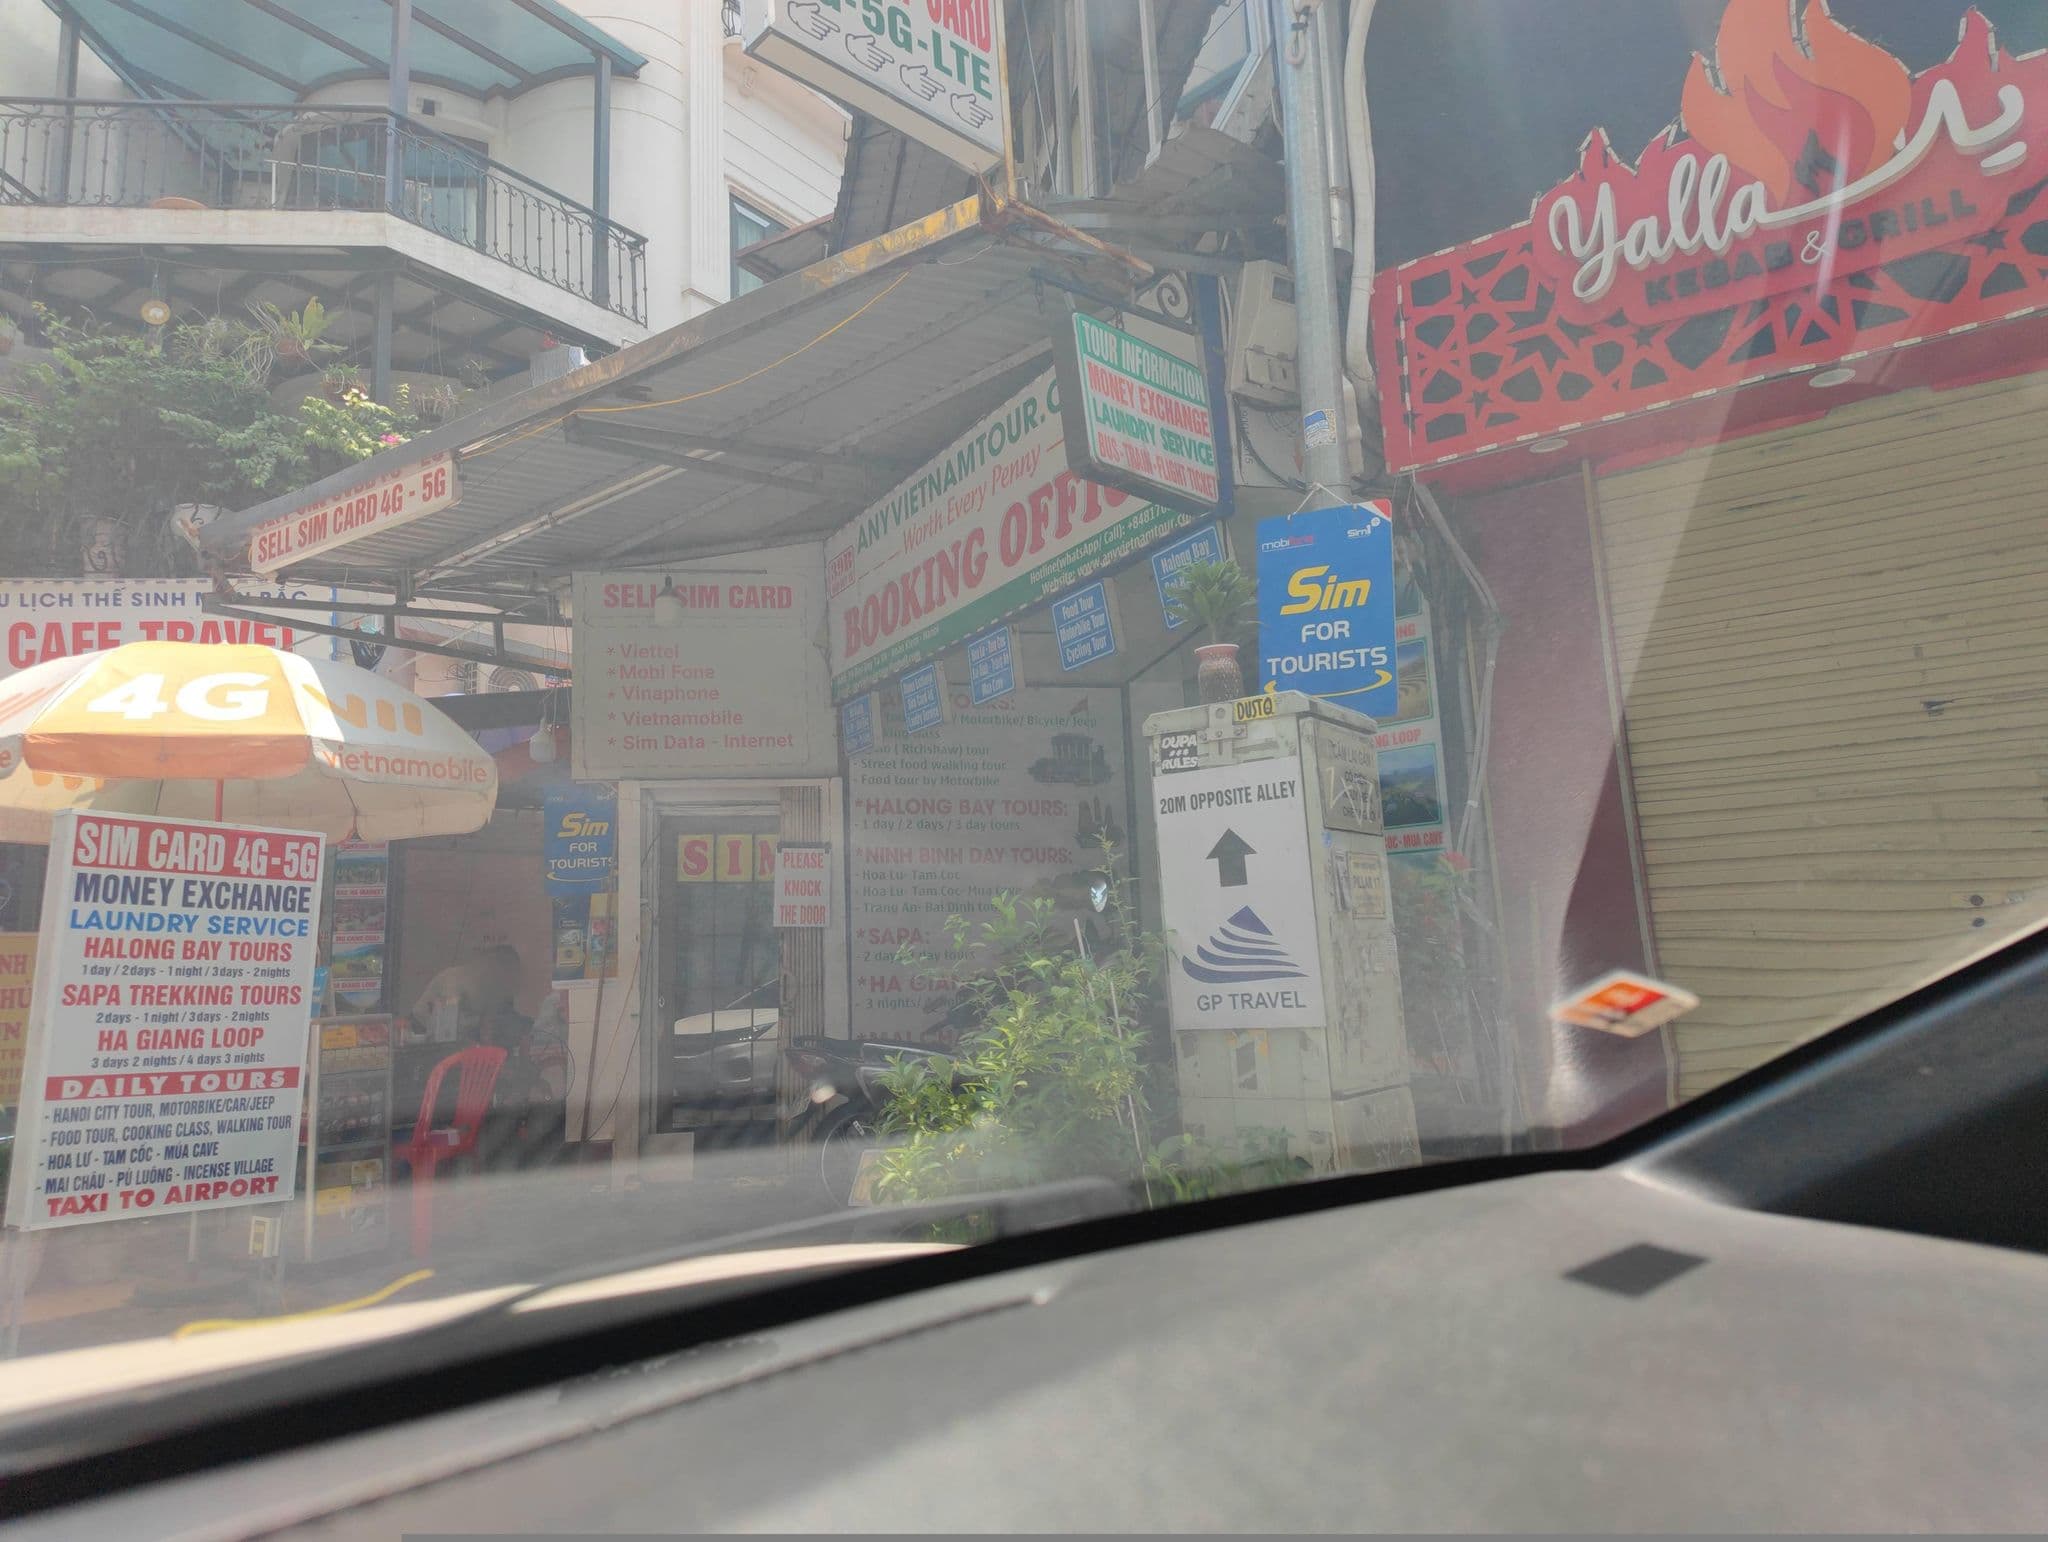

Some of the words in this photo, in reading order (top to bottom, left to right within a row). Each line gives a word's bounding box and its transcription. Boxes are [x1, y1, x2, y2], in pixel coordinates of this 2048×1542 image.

[1548, 153, 1768, 302] Yalla
[1644, 240, 1794, 303] KEBAB
[1801, 230, 1828, 263] &
[1840, 189, 1977, 250] GRILL
[1082, 320, 1118, 364] TOUR
[1121, 338, 1206, 404] INFORMATION
[1087, 361, 1135, 409] MONEY
[1139, 385, 1211, 438] EXCHANGE
[1093, 397, 1155, 446] LAUNDRY
[1160, 427, 1213, 467] SERVICE
[903, 507, 944, 554] Worth
[947, 481, 987, 526] Every
[992, 444, 1041, 496] Penny
[257, 529, 293, 563] SELL
[297, 512, 328, 548] SIM
[332, 493, 378, 535] CARD
[381, 483, 404, 516] 4G
[422, 467, 446, 503] 5G
[20, 592, 73, 613] LỊCH
[82, 587, 126, 607] THẾ
[131, 592, 193, 607] SINH
[672, 584, 720, 609] SIM
[728, 584, 793, 609] CARD
[843, 527, 988, 659] BOOKING
[1280, 565, 1371, 615] Sim
[1301, 620, 1350, 643] FOR
[620, 644, 679, 659] Viettel
[1267, 646, 1388, 676] TOURISTS
[619, 665, 665, 680] Mobi
[671, 665, 715, 679] Fone
[87, 671, 272, 721] 4G
[623, 685, 720, 703] Vinaphone
[623, 710, 744, 726] Vietnamobile
[623, 736, 658, 750] Sim
[664, 735, 705, 749] Data
[724, 734, 793, 748] Internet
[323, 749, 488, 784] vietnamobile
[959, 800, 996, 816] BAY
[1160, 795, 1187, 815] 20M
[1190, 786, 1253, 811] OPPOSITE
[1257, 780, 1296, 802] ALLEY
[557, 812, 609, 837] Sim
[77, 822, 140, 867] SIM
[148, 829, 226, 873] CARD
[569, 842, 597, 853] FOR
[783, 853, 824, 869] PLEASE
[919, 848, 963, 864] BINH
[973, 848, 1005, 864] DAY
[74, 872, 175, 908] MONEY
[182, 879, 312, 914] EXCHANGE
[784, 880, 822, 897] KNOCK
[70, 908, 200, 934] LAUNDRY
[207, 915, 309, 937] SERVICE
[779, 905, 797, 923] THE
[799, 905, 826, 925] DOOR
[84, 937, 176, 960] HALONG
[182, 940, 223, 961] BAY
[228, 942, 292, 962] TOURS
[62, 984, 121, 1006] SAPA
[130, 984, 234, 1006] TREKKING
[240, 985, 302, 1006] TOURS
[1196, 995, 1223, 1012] GP
[1231, 990, 1306, 1010] TRAVEL
[97, 1029, 128, 1052] HA
[136, 1028, 204, 1051] GIANG
[211, 1027, 265, 1049] LOOP
[91, 1057, 99, 1069] 3
[102, 1056, 129, 1069] days
[132, 1056, 140, 1068] 2
[143, 1055, 178, 1069] nights
[186, 1054, 194, 1066] 4
[197, 1054, 222, 1068] days
[224, 1053, 232, 1065] 3
[234, 1052, 265, 1066] nights
[61, 1076, 170, 1099] DAILY
[180, 1070, 286, 1093] TOURS
[53, 1106, 91, 1124] HANOI
[94, 1105, 119, 1121] CITY
[123, 1103, 156, 1119] TOUR,
[159, 1095, 276, 1116] MOTORBIKE/CAR/JEEP
[51, 1130, 82, 1147] FOOD
[86, 1128, 118, 1144] TOUR,
[122, 1123, 172, 1141] COOKING
[176, 1120, 214, 1138] CLASS,
[217, 1117, 264, 1134] WALKING
[267, 1115, 292, 1130] TOUR
[47, 1154, 72, 1170] HOA
[103, 1150, 127, 1166] TAM
[193, 1141, 220, 1158] CAVE
[44, 1178, 70, 1194] MAI
[183, 1161, 231, 1180] INCENSE
[234, 1157, 275, 1175] VILLAGE
[46, 1192, 109, 1217] TAXI
[119, 1188, 156, 1210] TO
[163, 1175, 280, 1205] AIRPORT
